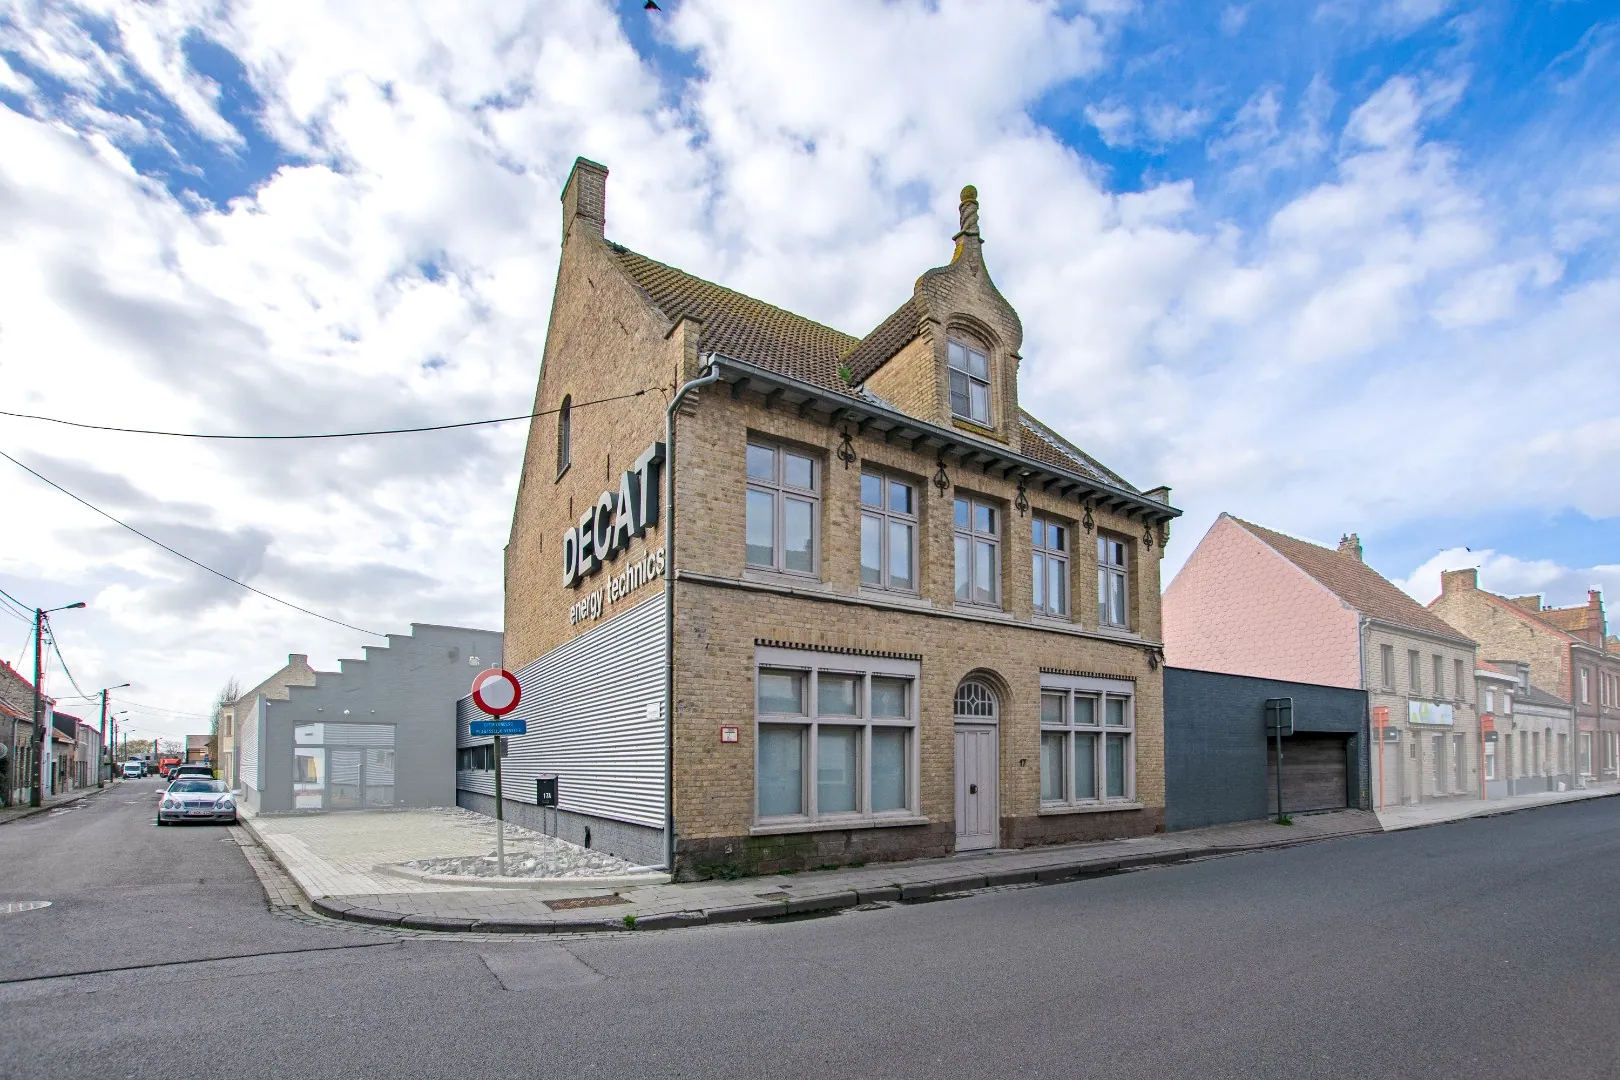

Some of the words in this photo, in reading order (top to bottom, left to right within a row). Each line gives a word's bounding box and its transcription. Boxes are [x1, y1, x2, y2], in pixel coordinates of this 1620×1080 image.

[563, 441, 664, 588] DECAT
[570, 587, 603, 624] energy
[607, 547, 665, 604] technics
[1020, 758, 1027, 767] 17
